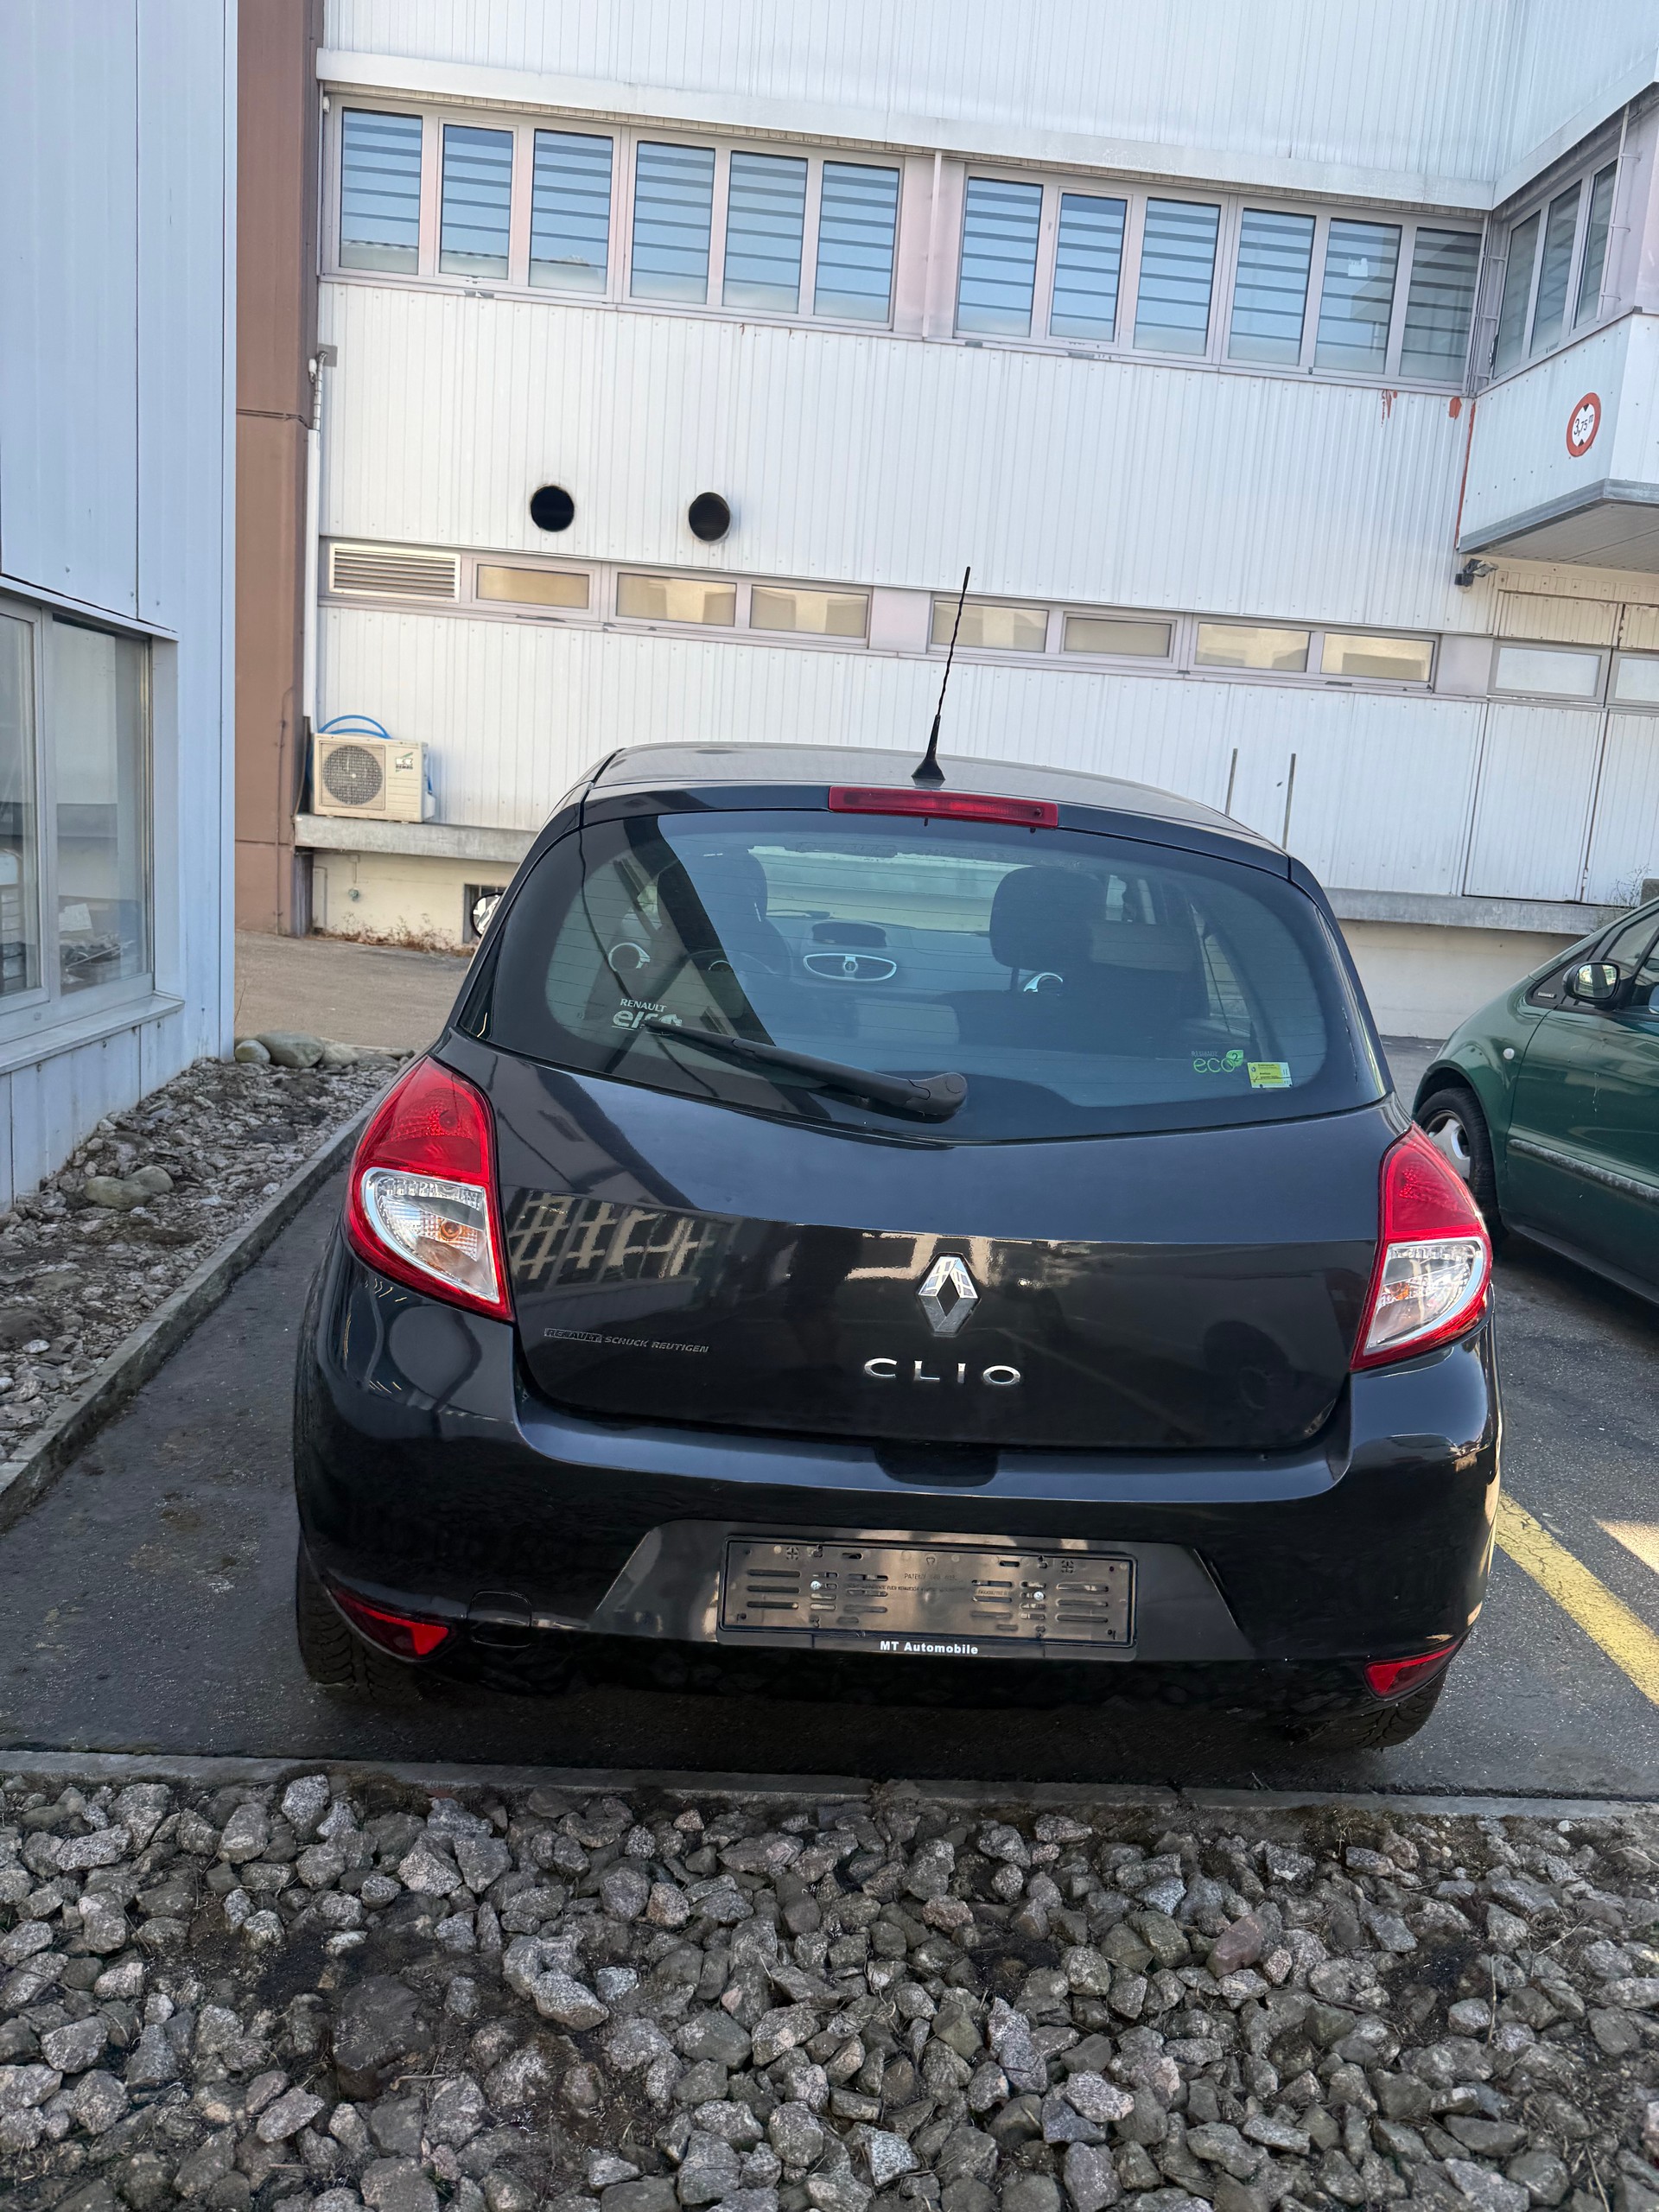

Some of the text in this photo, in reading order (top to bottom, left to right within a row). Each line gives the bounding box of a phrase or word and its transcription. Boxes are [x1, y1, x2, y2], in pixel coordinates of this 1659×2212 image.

[1573, 418, 1588, 436] 3,75
[620, 998, 667, 1013] RENAULT
[605, 1336, 649, 1347] SCHUCK
[651, 1341, 709, 1353] REUTIGEN
[863, 1357, 1021, 1386] CLIO
[880, 1641, 979, 1655] MT Automobile
